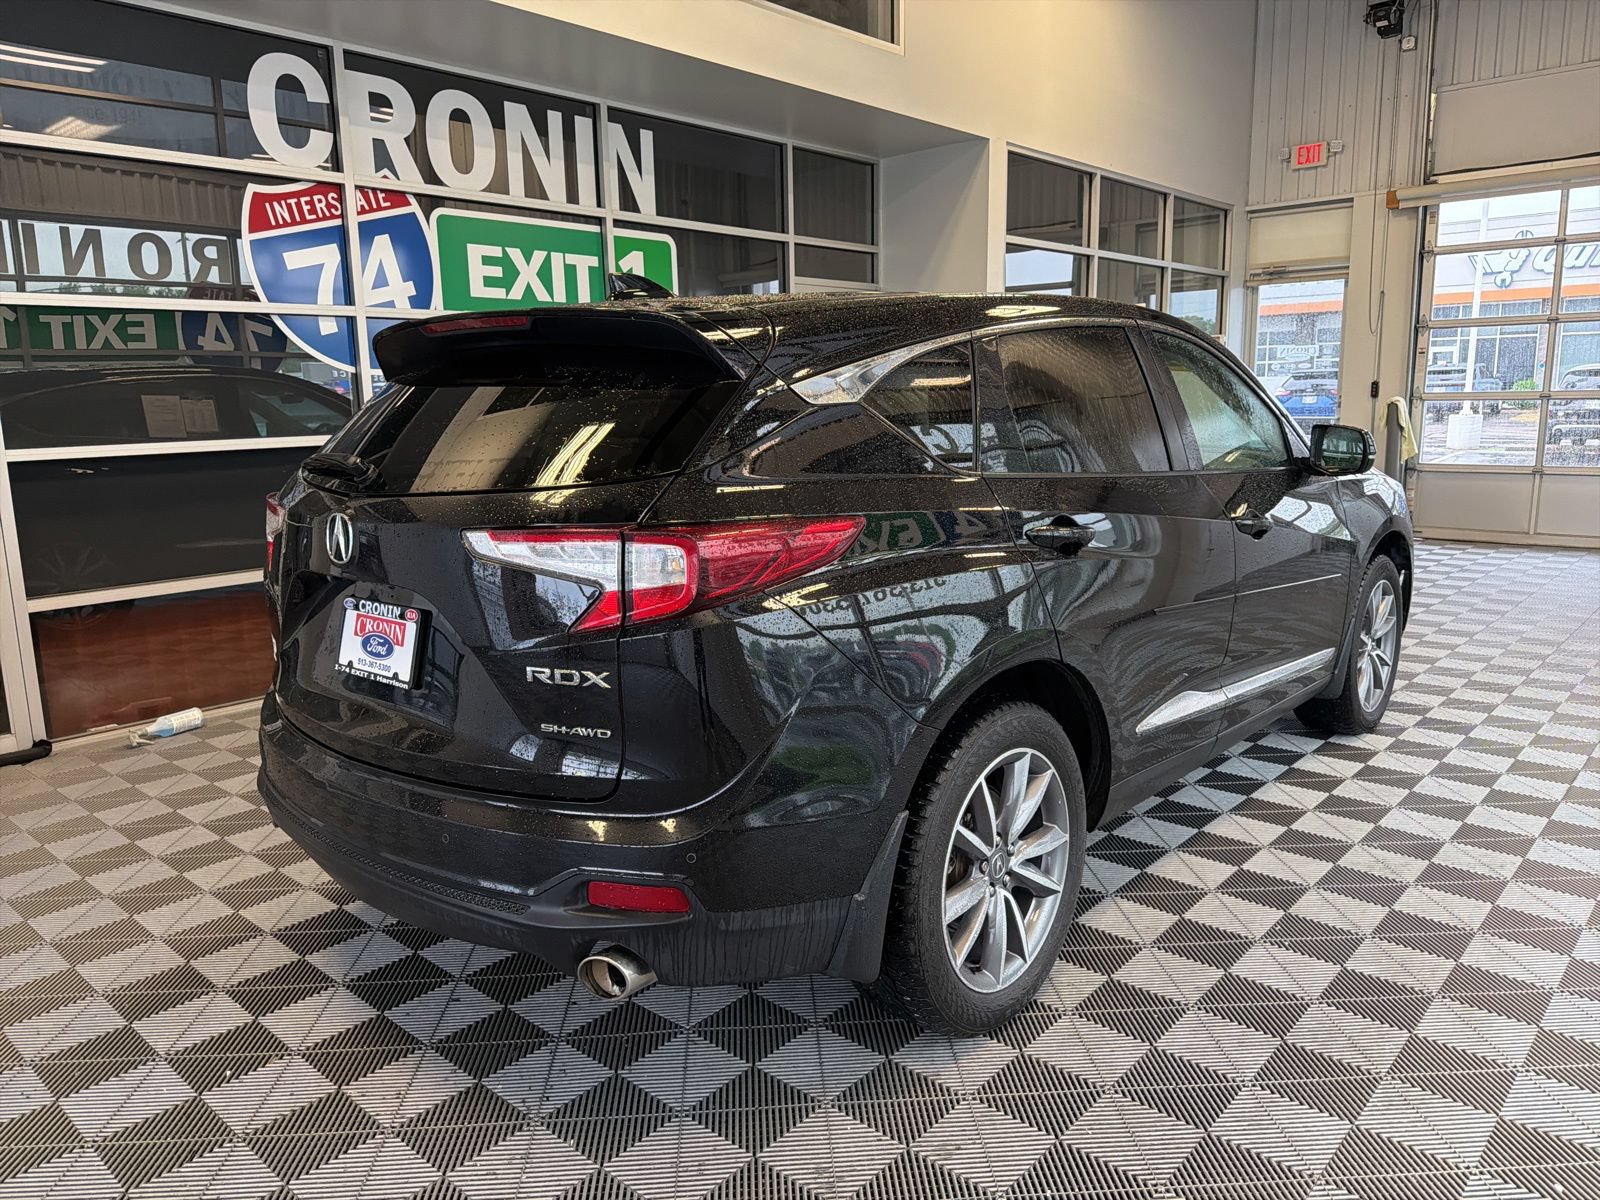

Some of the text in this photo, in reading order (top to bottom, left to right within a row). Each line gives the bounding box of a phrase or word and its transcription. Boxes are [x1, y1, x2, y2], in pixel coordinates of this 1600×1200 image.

[247, 52, 656, 215] CRONIN
[1296, 144, 1323, 165] EXIT
[264, 188, 392, 226] INTERSATE
[466, 243, 600, 304] EXIT
[282, 234, 417, 337] 74
[359, 600, 401, 619] CRONIN
[357, 617, 405, 646] CRONIN
[367, 636, 389, 655] Ford
[351, 668, 369, 678] EXIT
[376, 675, 409, 690] Harrison
[526, 666, 612, 689] RDX
[540, 723, 612, 739] SH-AWD
